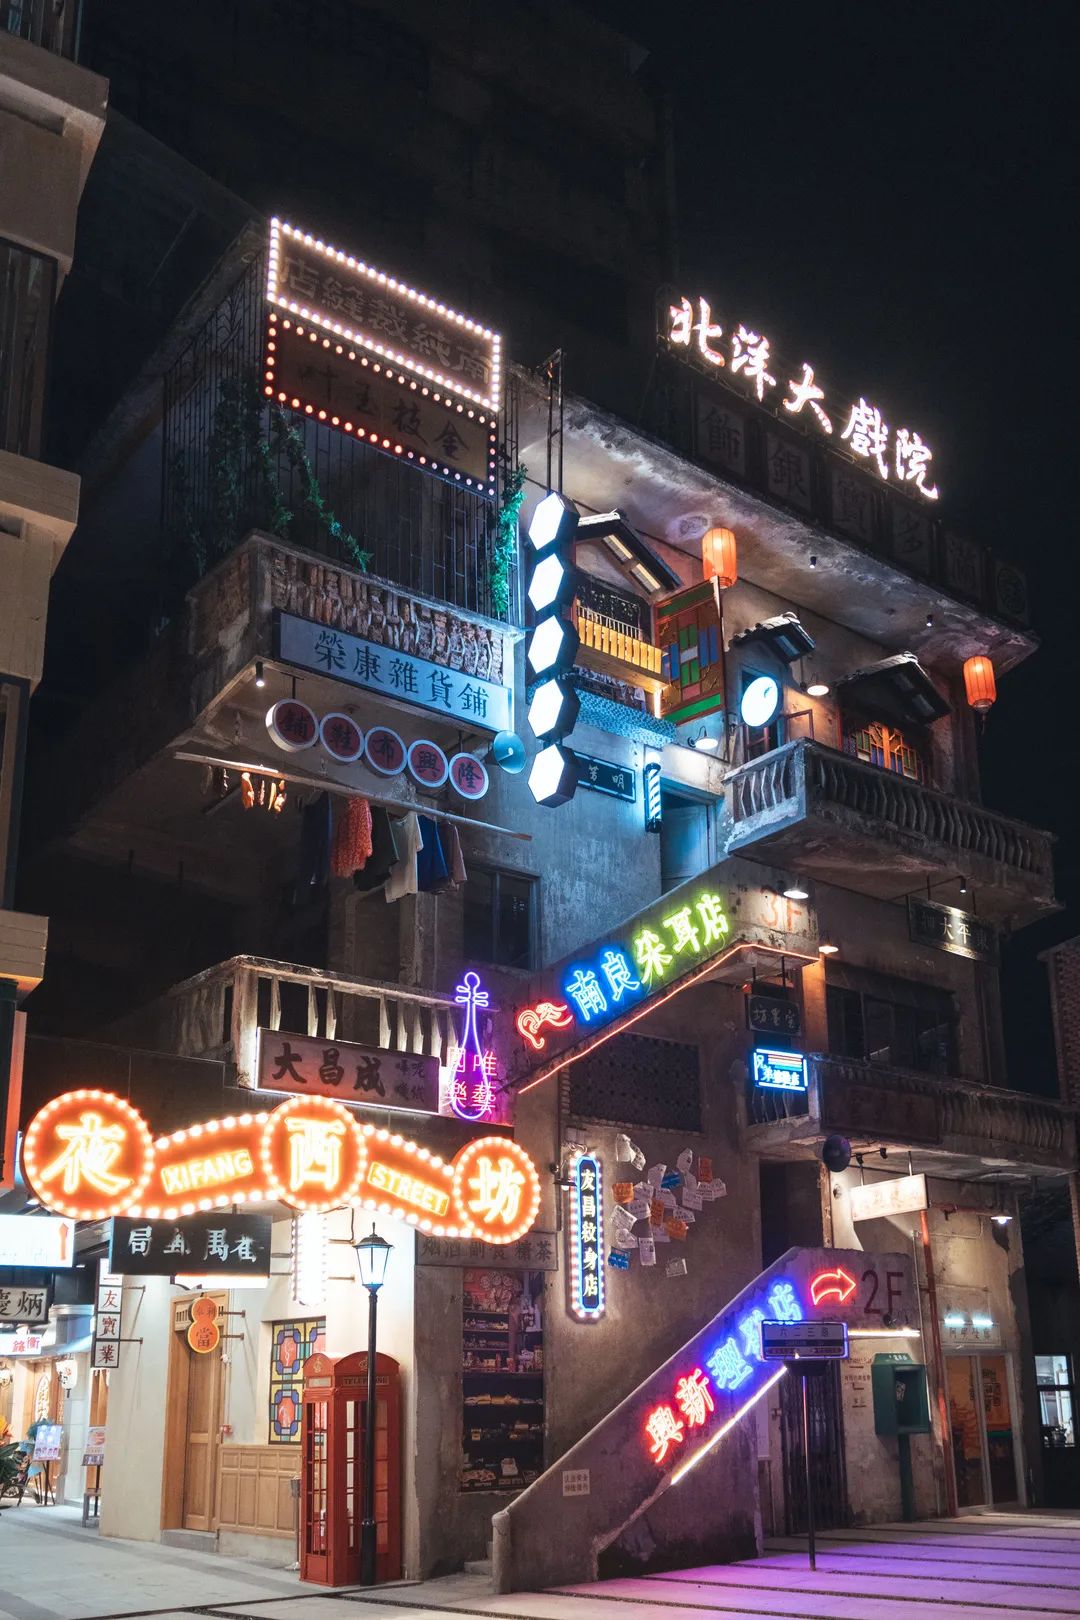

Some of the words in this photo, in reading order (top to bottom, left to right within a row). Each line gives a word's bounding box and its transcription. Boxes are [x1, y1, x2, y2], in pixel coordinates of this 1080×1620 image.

[670, 297, 939, 499] 北洋大戲院
[314, 630, 490, 719] 榮康雜貨鋪
[759, 886, 802, 930] 3F
[164, 1150, 253, 1193] XIFANG
[284, 1117, 346, 1192] 西
[371, 1165, 449, 1214] STREET
[468, 1157, 526, 1224] 坊
[580, 1168, 599, 1297] 友昌紋身店
[861, 1269, 904, 1316] 2F
